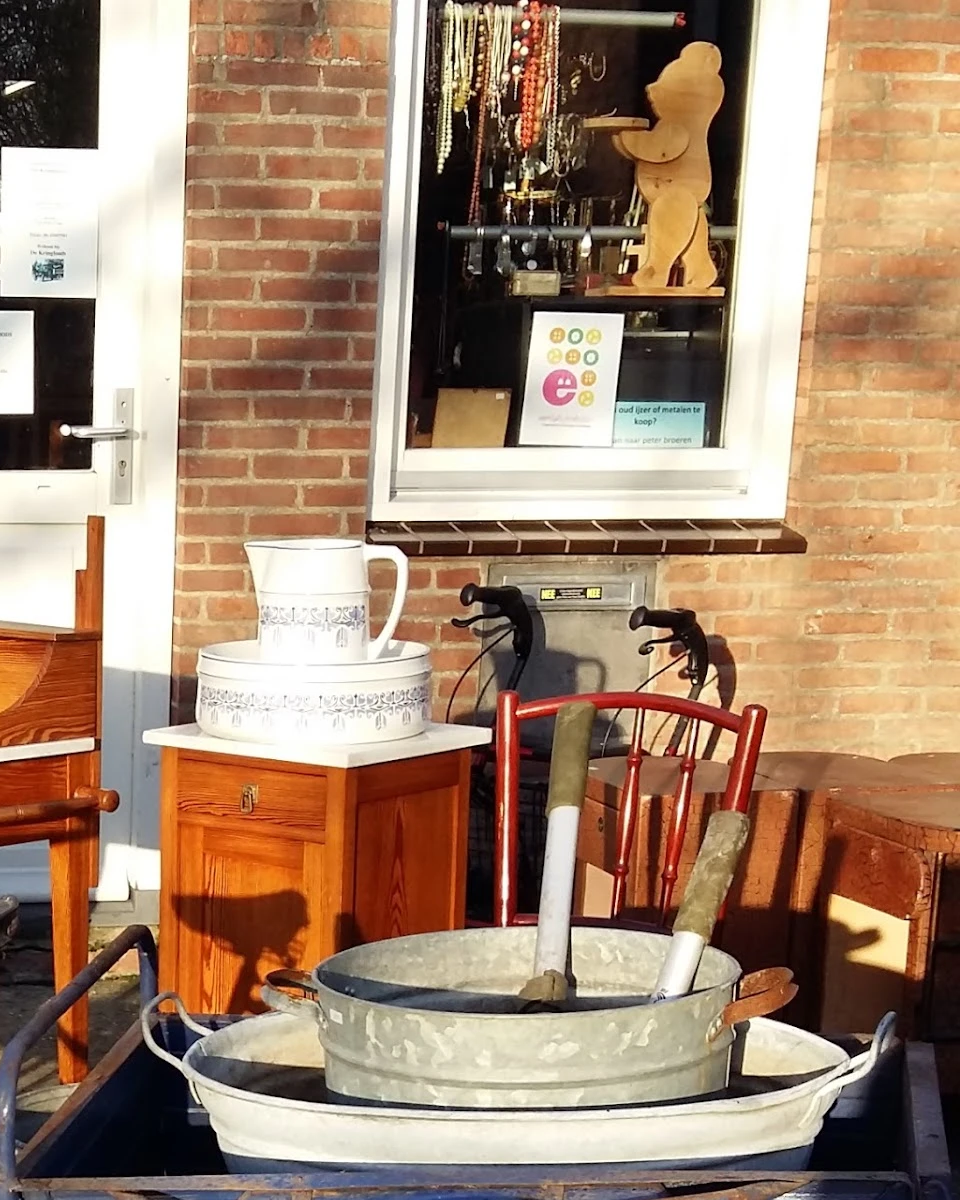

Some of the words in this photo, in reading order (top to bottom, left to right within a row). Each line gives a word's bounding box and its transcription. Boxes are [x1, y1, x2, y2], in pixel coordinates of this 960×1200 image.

[618, 406, 634, 414] oud
[635, 406, 652, 415] ijzer
[652, 406, 661, 414] of
[661, 406, 692, 414] metalen
[693, 406, 701, 414] te
[634, 417, 658, 427] koop?
